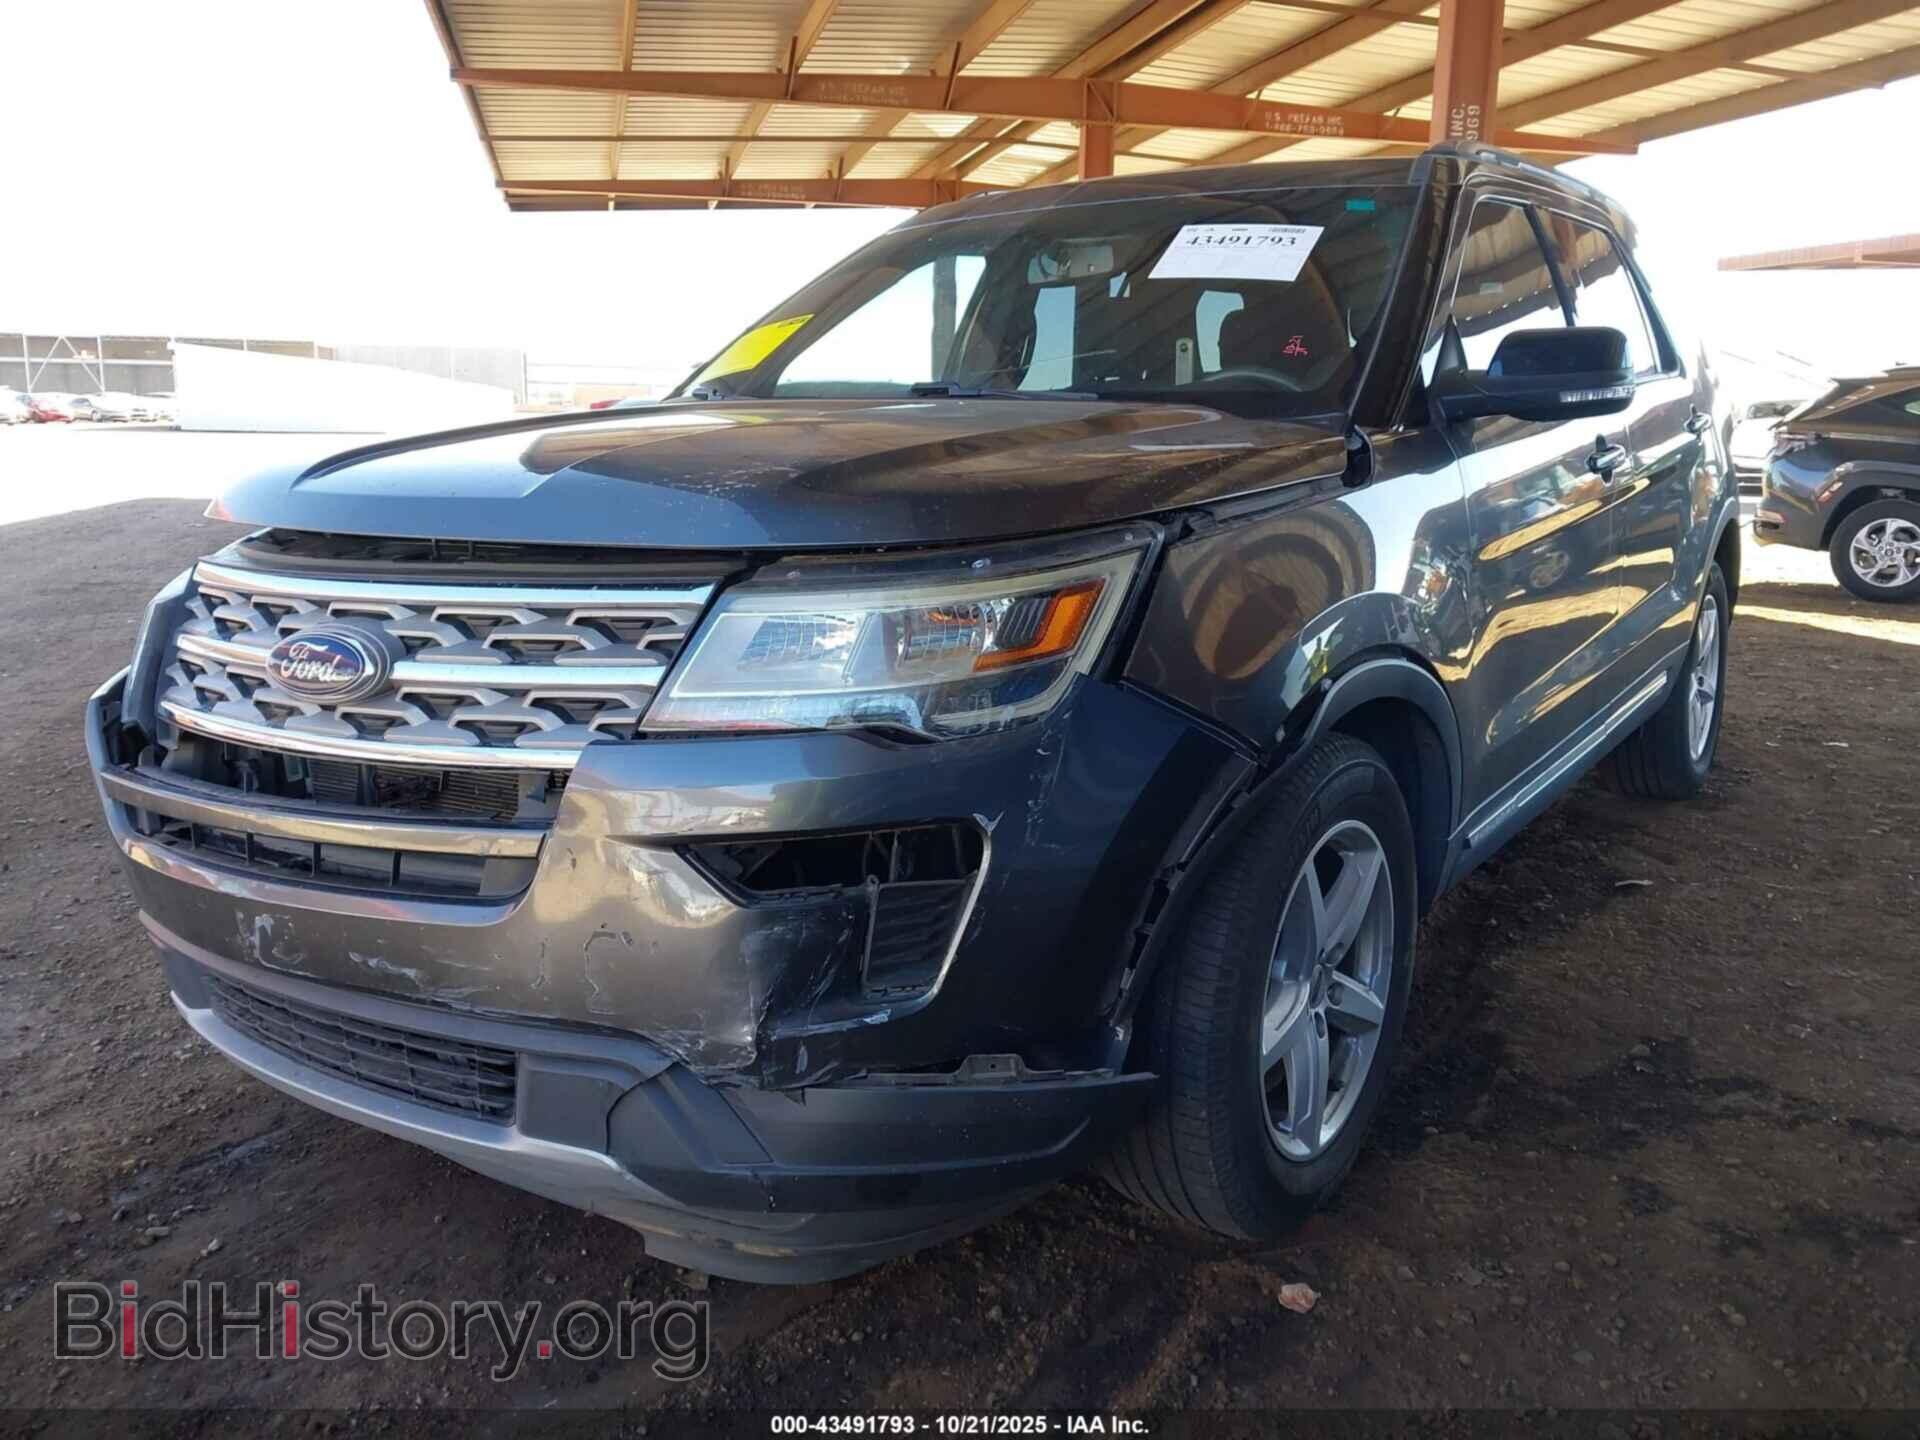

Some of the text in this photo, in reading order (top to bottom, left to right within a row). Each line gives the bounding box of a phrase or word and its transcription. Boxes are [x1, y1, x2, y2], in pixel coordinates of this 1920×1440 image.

[1450, 103, 1465, 137] INC.
[1185, 235, 1297, 247] 43491793
[280, 641, 353, 682] Ford
